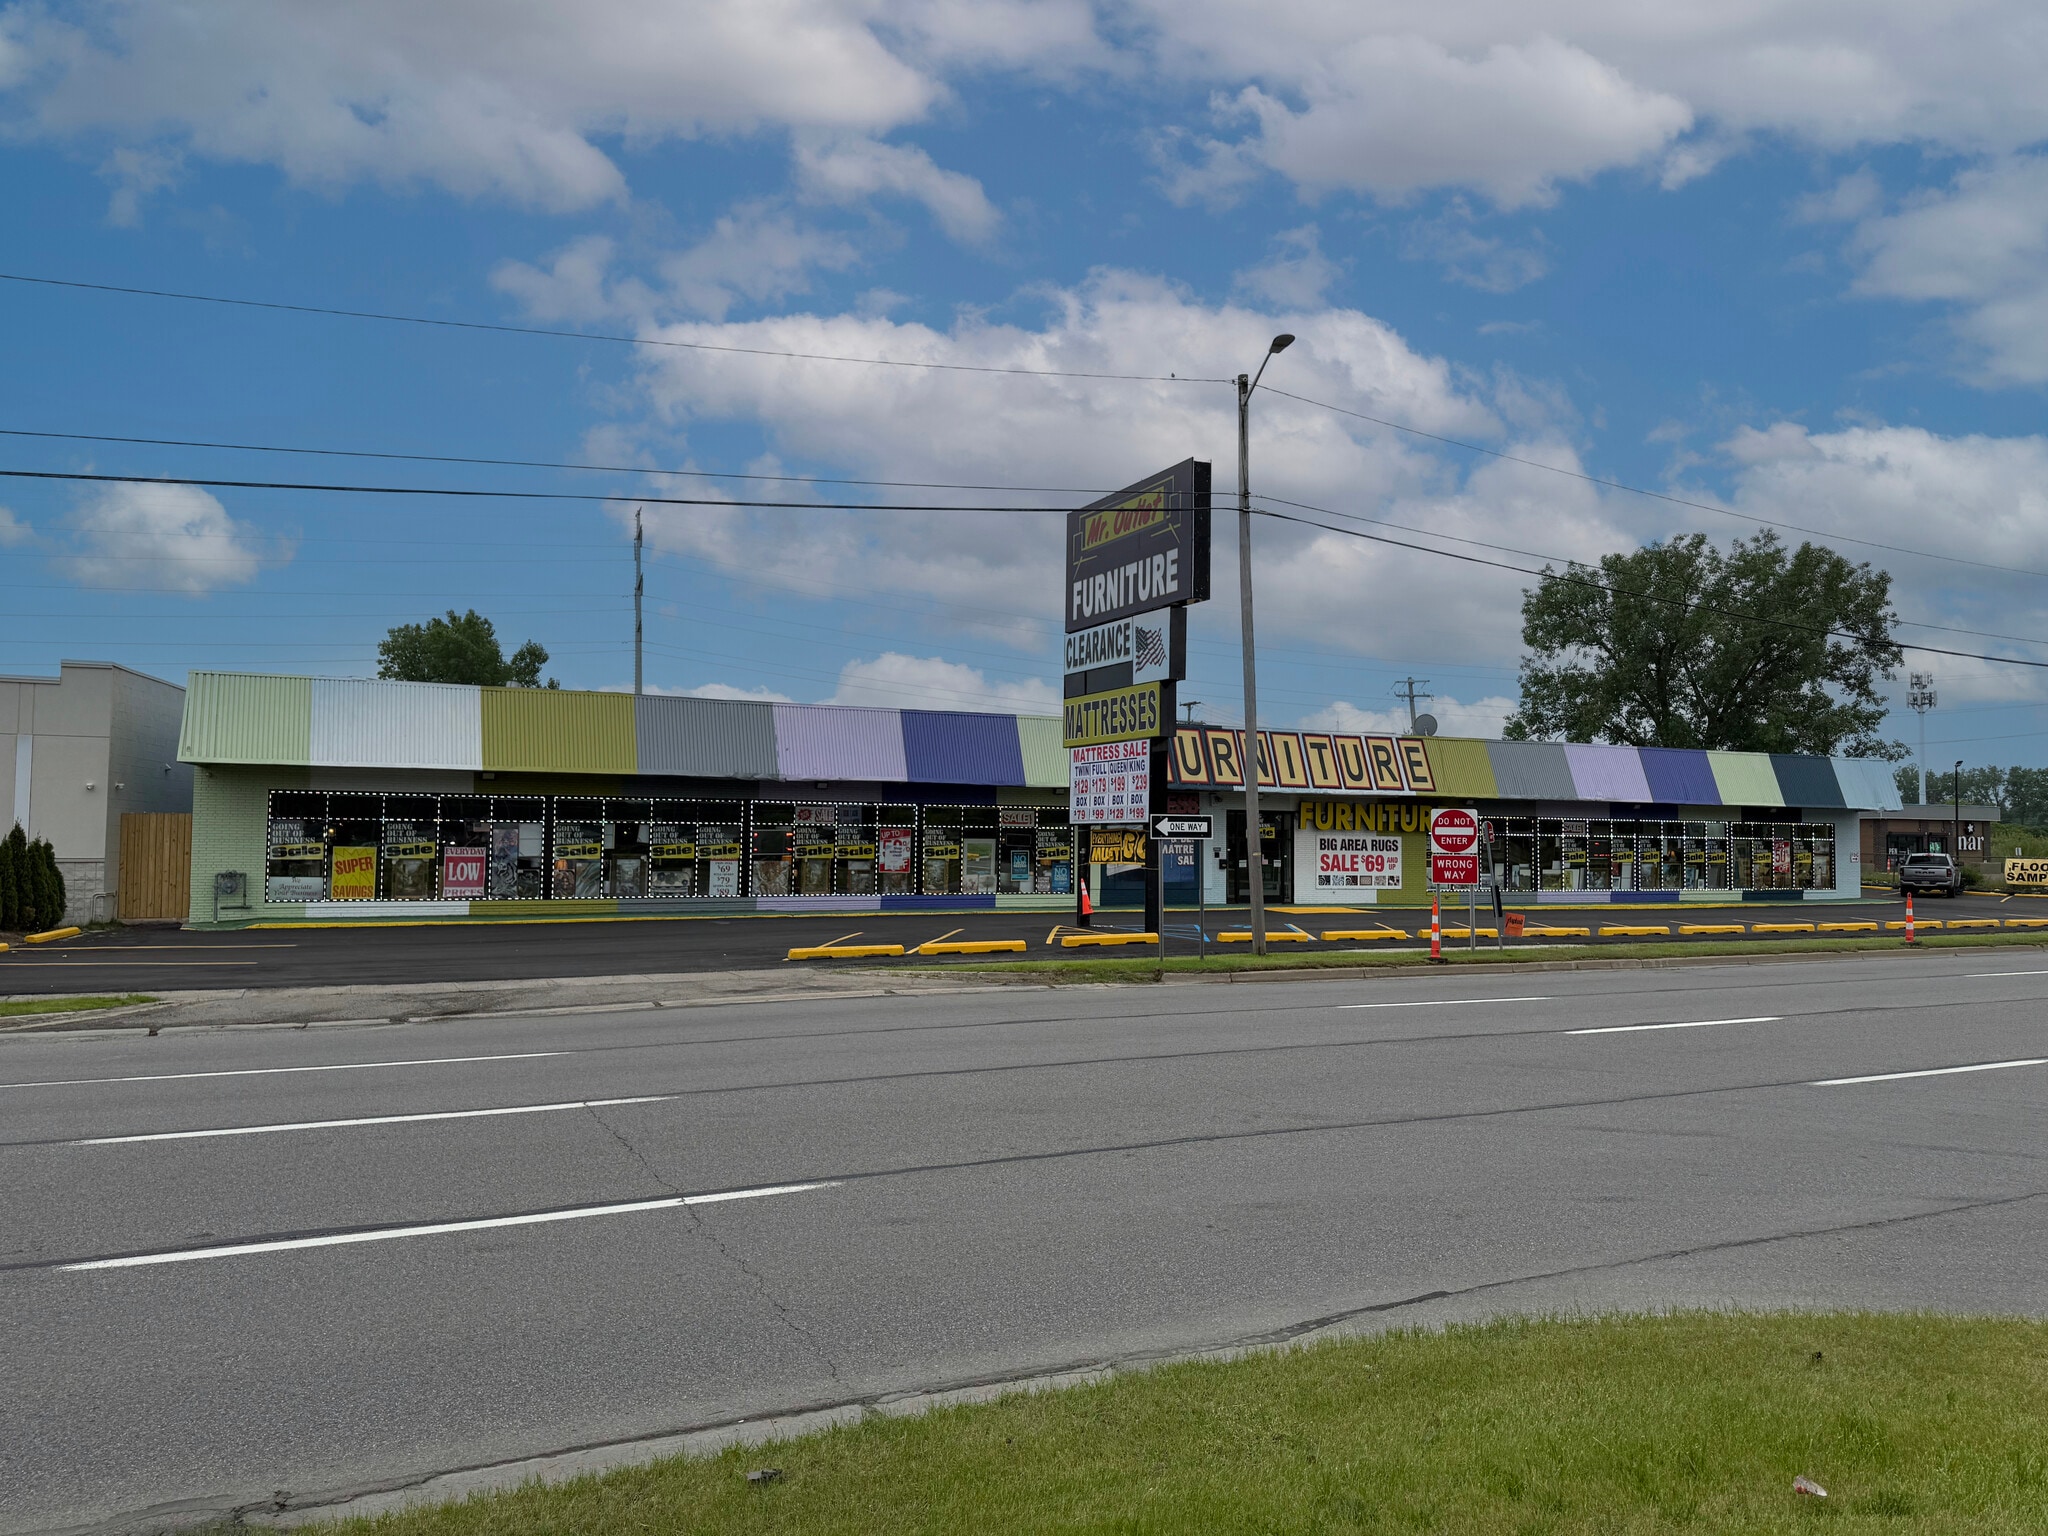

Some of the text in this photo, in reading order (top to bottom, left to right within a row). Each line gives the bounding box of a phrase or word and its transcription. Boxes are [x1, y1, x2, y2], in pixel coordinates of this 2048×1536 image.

[1087, 490, 1162, 547] Mr. Outlet
[1073, 548, 1179, 622] FURNITURE
[1066, 622, 1131, 670] CLEARANCE
[1065, 690, 1157, 740] MATTRESSES
[1073, 741, 1148, 764] MATTRESS SALE
[1176, 735, 1429, 784] URNITURE
[1075, 759, 1145, 777] TWIN FULL QUEEN KING
[1074, 774, 1148, 794] $129 $179 $199 $239
[1076, 793, 1143, 807] BOX BOX BOX BOX
[815, 808, 833, 822] SALE
[1002, 812, 1033, 825] SALE!
[1074, 807, 1144, 820] $79 $99 $129 $199
[1299, 801, 1432, 832] FURNITUR
[1438, 817, 1471, 825] DO NOT
[272, 823, 300, 831] GOING
[1170, 823, 1203, 832] ONE WAY
[387, 836, 428, 844] BUSINESS
[1319, 838, 1399, 852] BIG AREA RUGS
[1441, 837, 1468, 845] ENTER
[1958, 835, 1985, 851] nar
[271, 846, 321, 858] Sale
[386, 845, 433, 857] Sale
[445, 847, 485, 856] EVERYDAY
[555, 846, 599, 857] Sale
[652, 846, 693, 857] Sale
[699, 846, 738, 857] Sale
[796, 846, 832, 857] Sale
[838, 846, 873, 857] Sale
[925, 847, 958, 857] Sale
[1038, 848, 1069, 859] Sale
[1091, 847, 1121, 862] MUST
[1564, 852, 1585, 861] Sale
[1612, 852, 1632, 861] Sale
[1013, 855, 1027, 863] NO
[1320, 854, 1399, 872] SALE $69 AND
[1685, 853, 1704, 862] Sale
[335, 856, 374, 876] SUPER
[1388, 863, 1396, 871] UP
[1437, 859, 1473, 869] WRONG
[448, 862, 481, 881] LOW
[1444, 870, 1466, 880] WAY
[2006, 872, 2048, 882] SAMP
[332, 884, 374, 898] SAVINGS
[444, 888, 484, 896] PRICES
